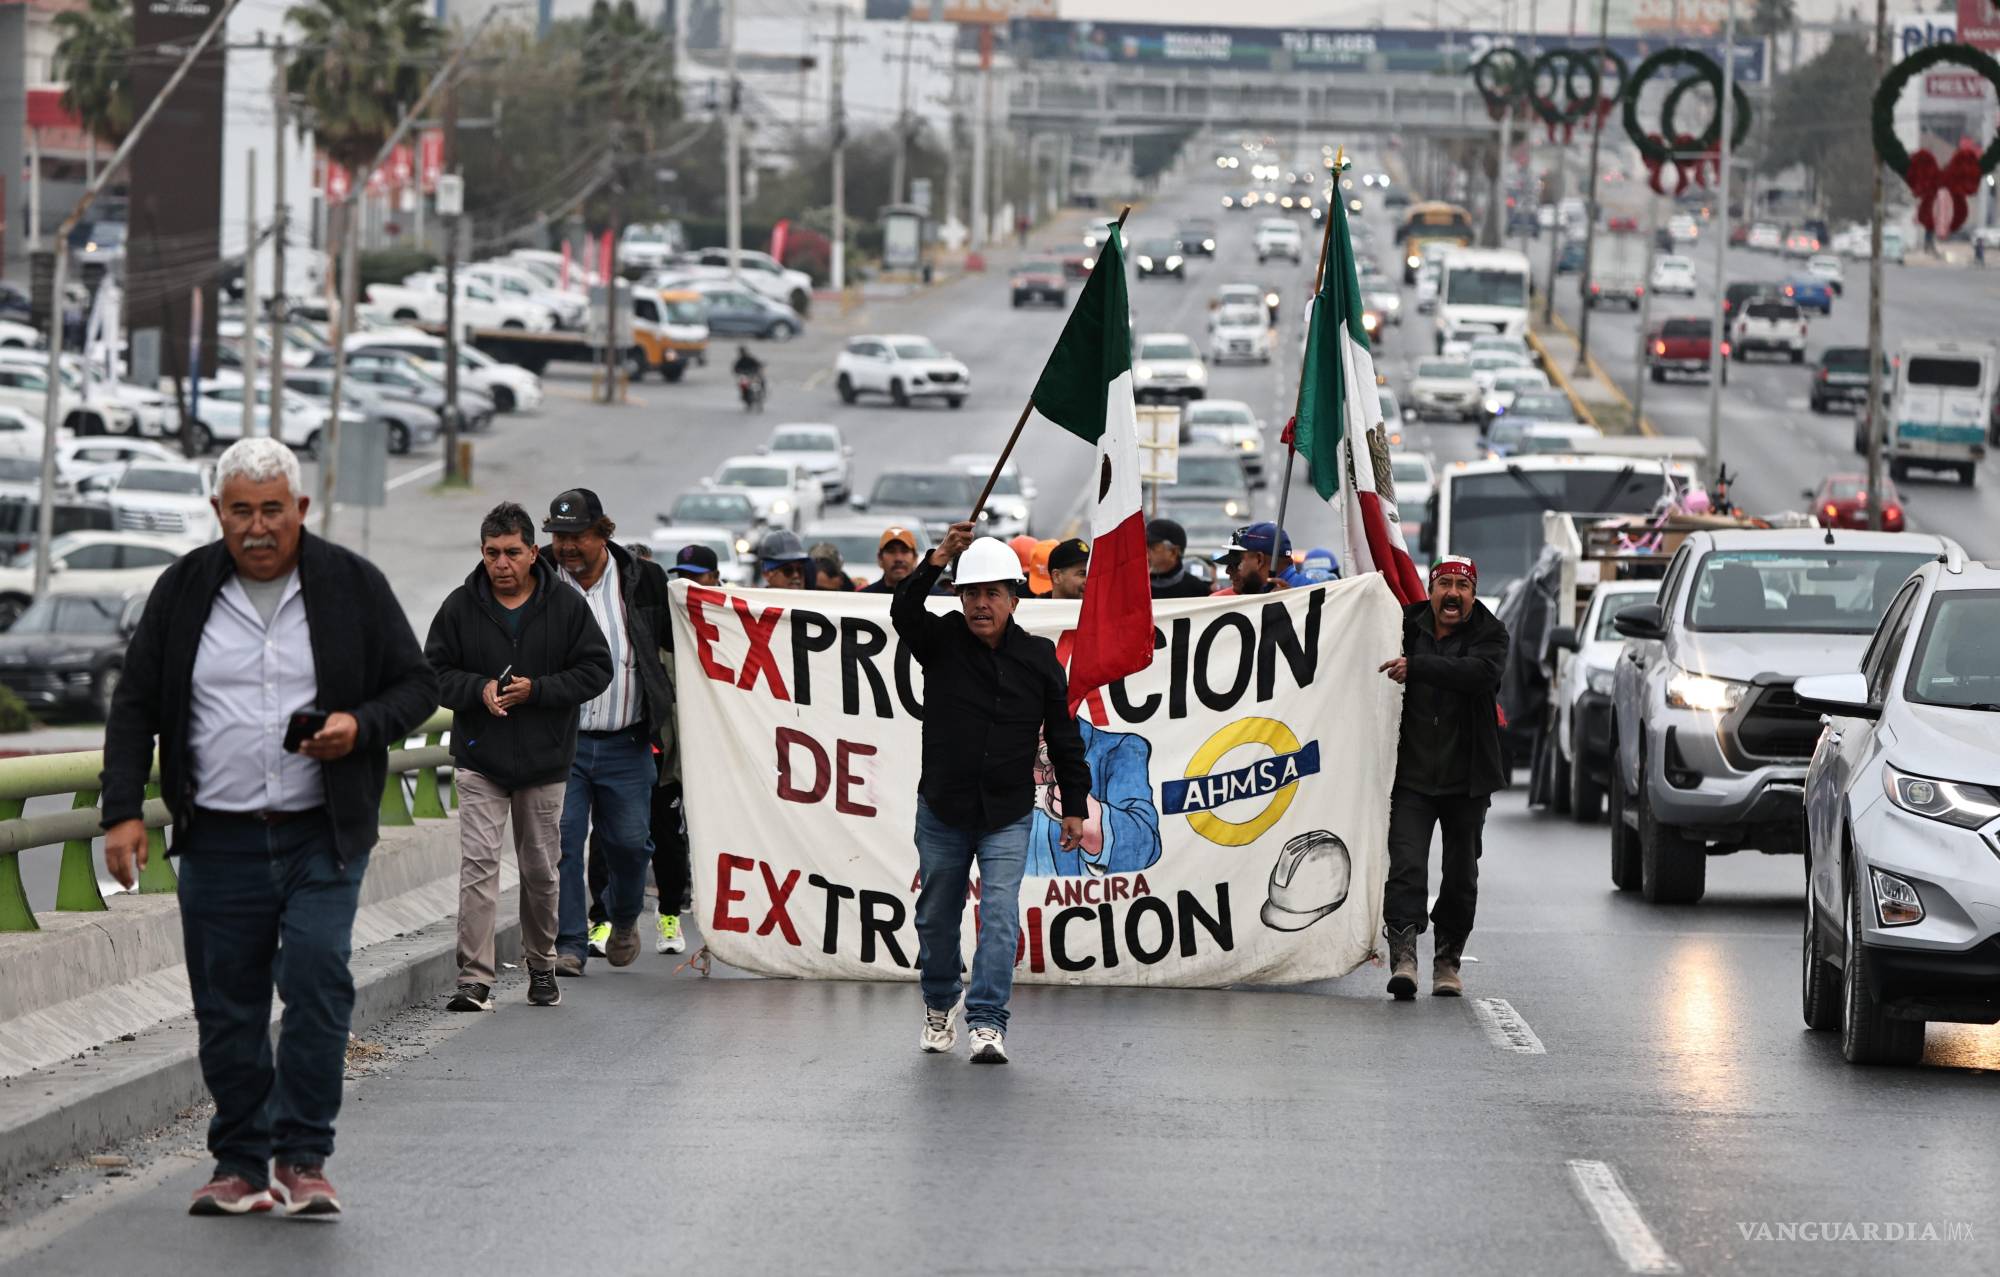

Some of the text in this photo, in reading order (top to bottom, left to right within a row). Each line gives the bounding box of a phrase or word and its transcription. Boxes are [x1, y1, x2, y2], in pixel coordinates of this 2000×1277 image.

[686, 585, 1326, 727] EXPRCION
[776, 726, 878, 817] DE
[1182, 756, 1299, 811] AHMSA
[713, 853, 1234, 973] EXTRICION
[1044, 873, 1151, 906] ANCIRA
